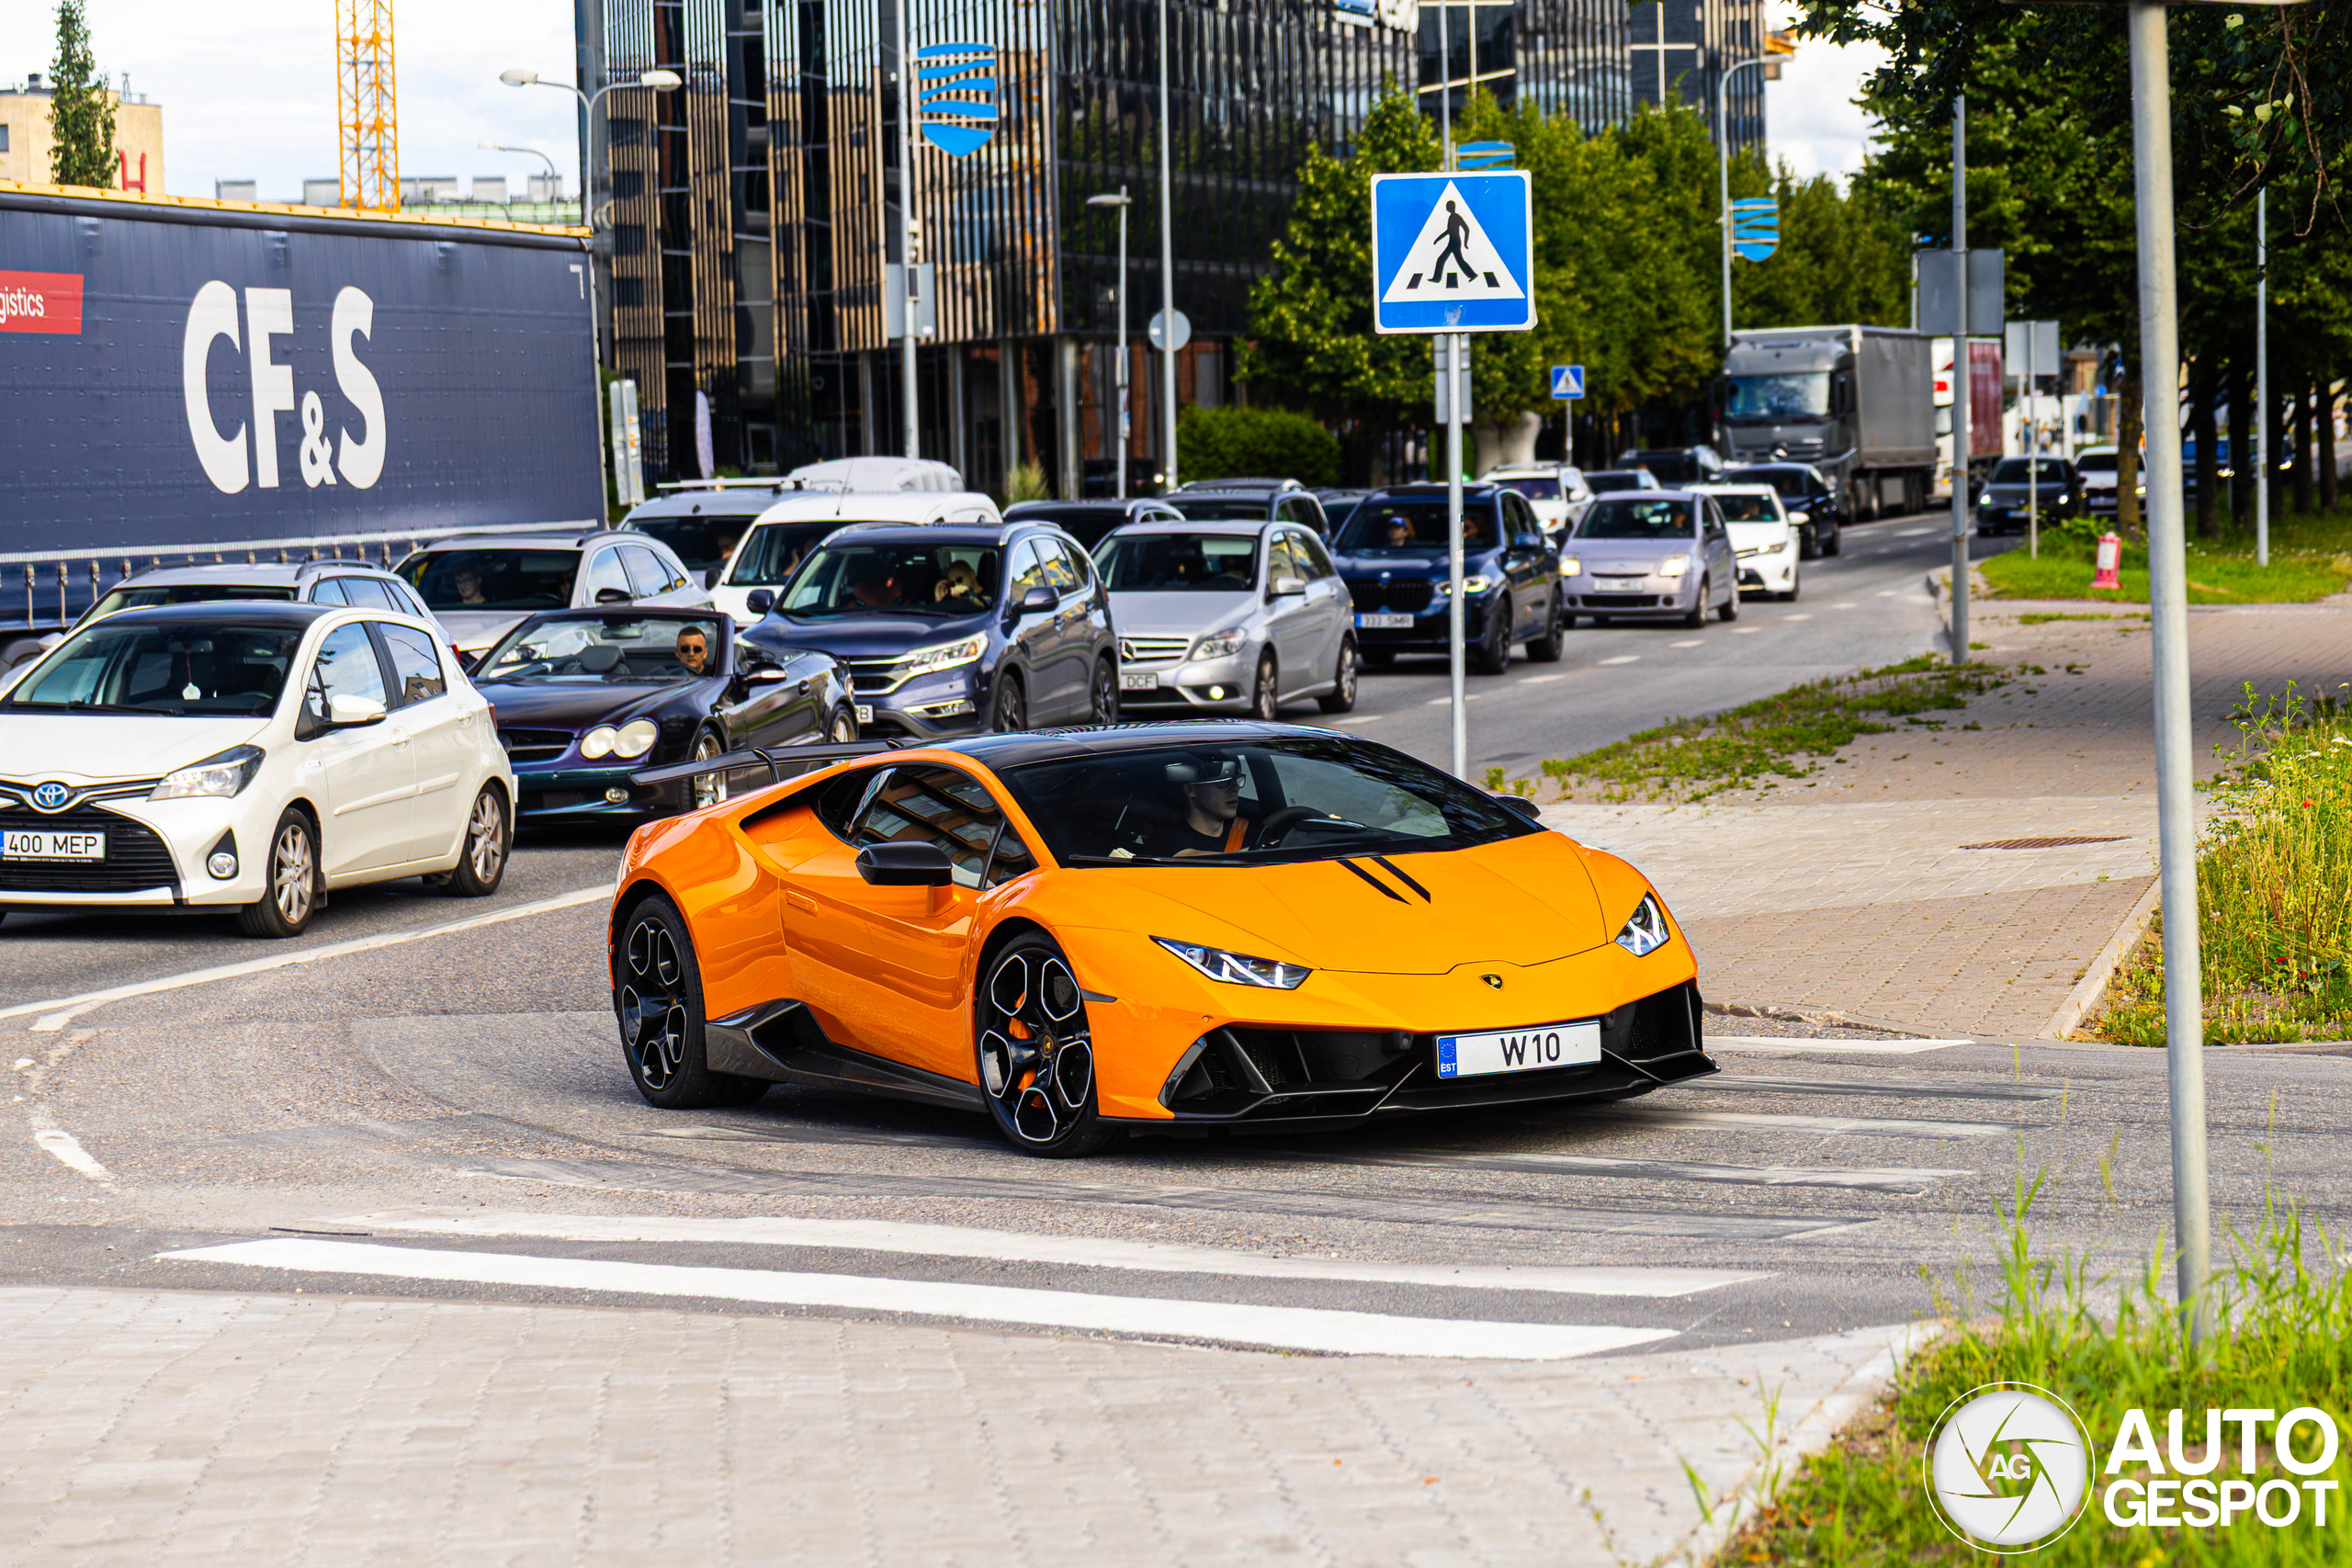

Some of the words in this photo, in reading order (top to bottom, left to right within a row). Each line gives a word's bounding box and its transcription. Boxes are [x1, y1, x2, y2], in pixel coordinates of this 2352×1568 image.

[183, 279, 387, 494] CF&S
[1386, 615, 1411, 626] SMR
[1126, 676, 1154, 688] DCF
[8, 834, 42, 853] 400
[52, 834, 97, 854] MEP
[1499, 1032, 1560, 1066] W10
[1440, 1062, 1456, 1073] EST
